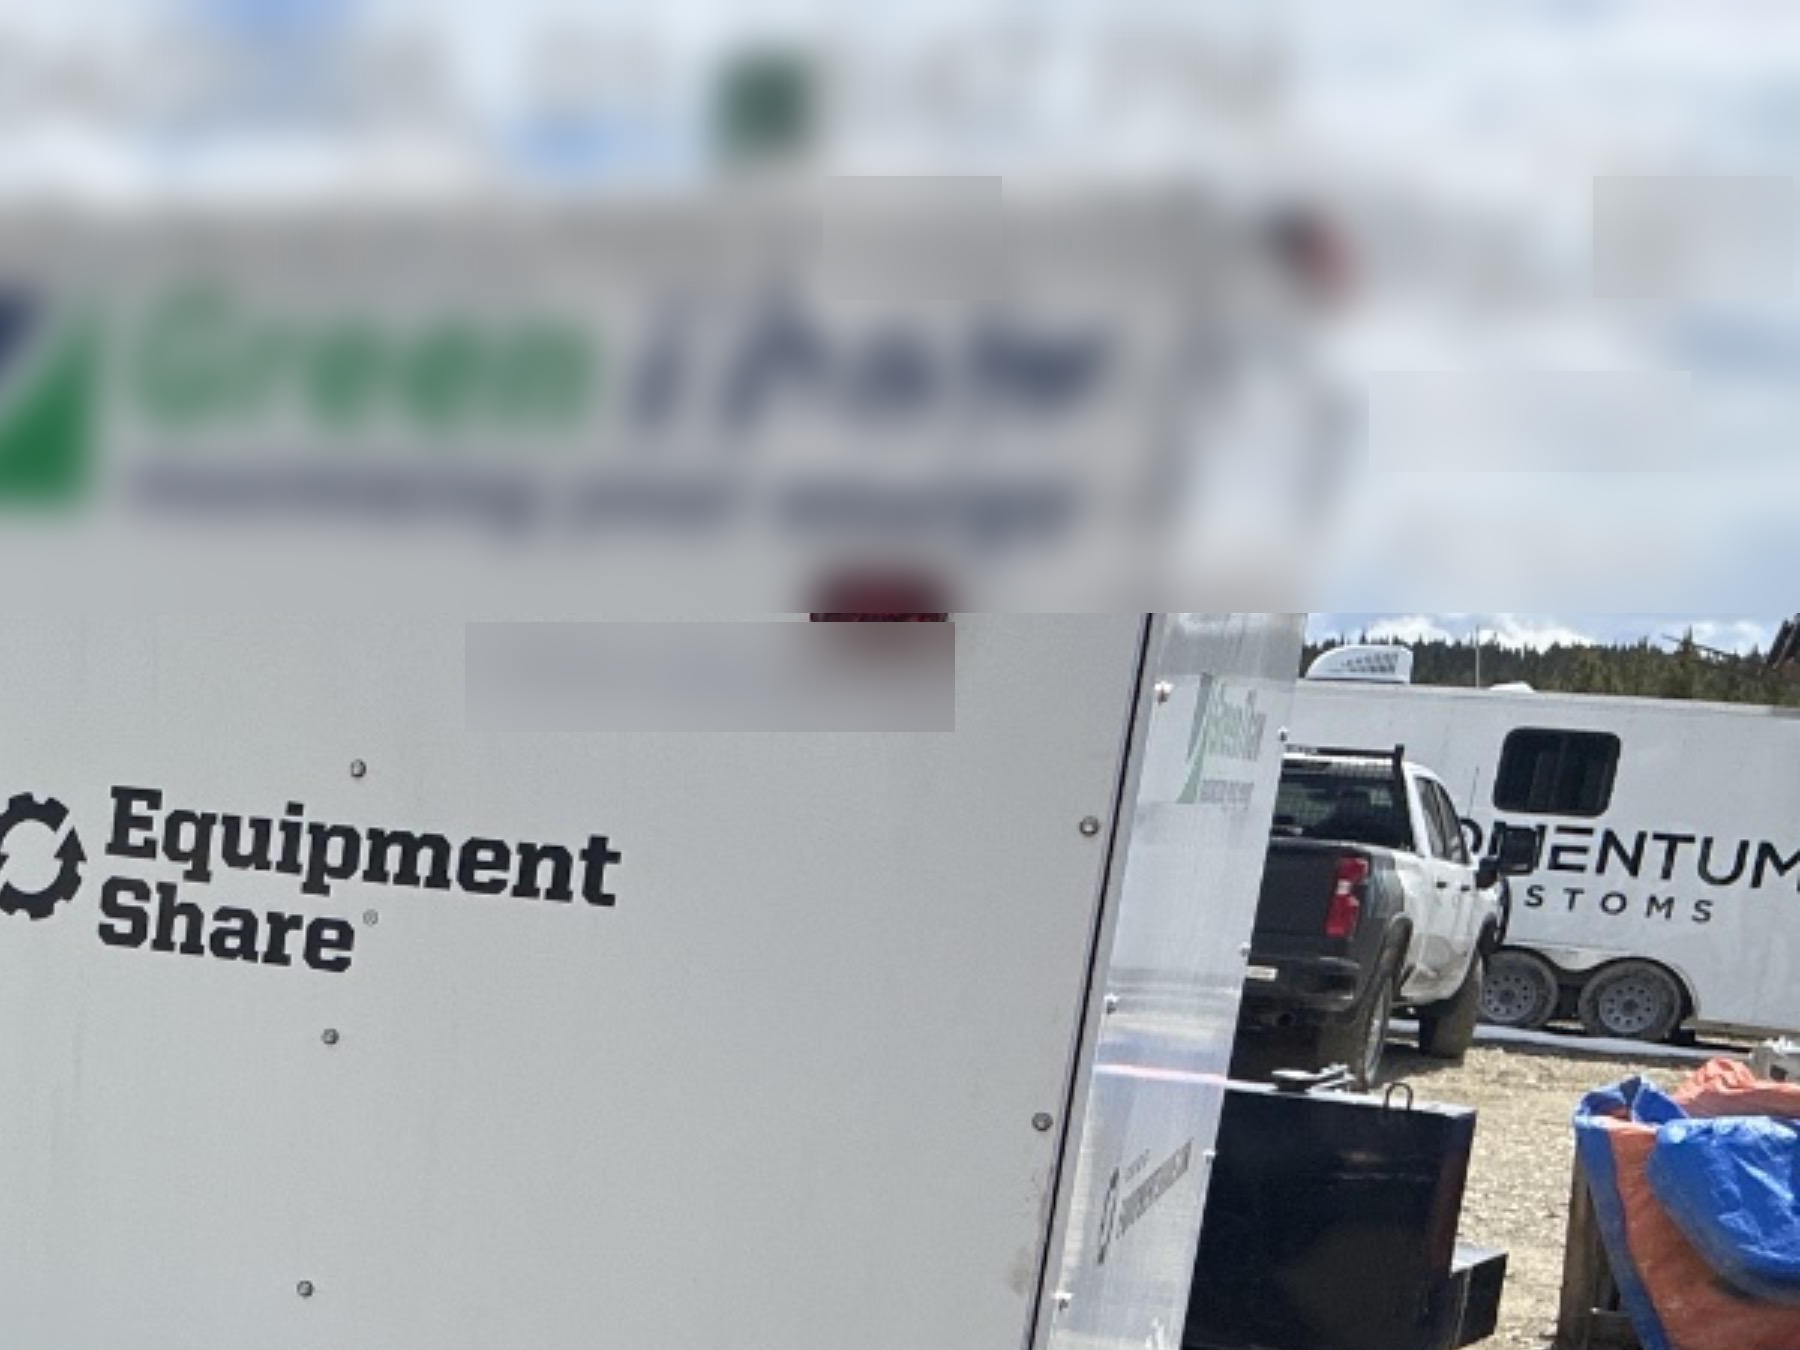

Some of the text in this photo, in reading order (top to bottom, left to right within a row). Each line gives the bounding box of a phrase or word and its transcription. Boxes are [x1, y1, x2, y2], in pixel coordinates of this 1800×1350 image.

[105, 786, 621, 906] Equipment
[98, 876, 355, 973] Share
[1524, 884, 1714, 923] STOMS
